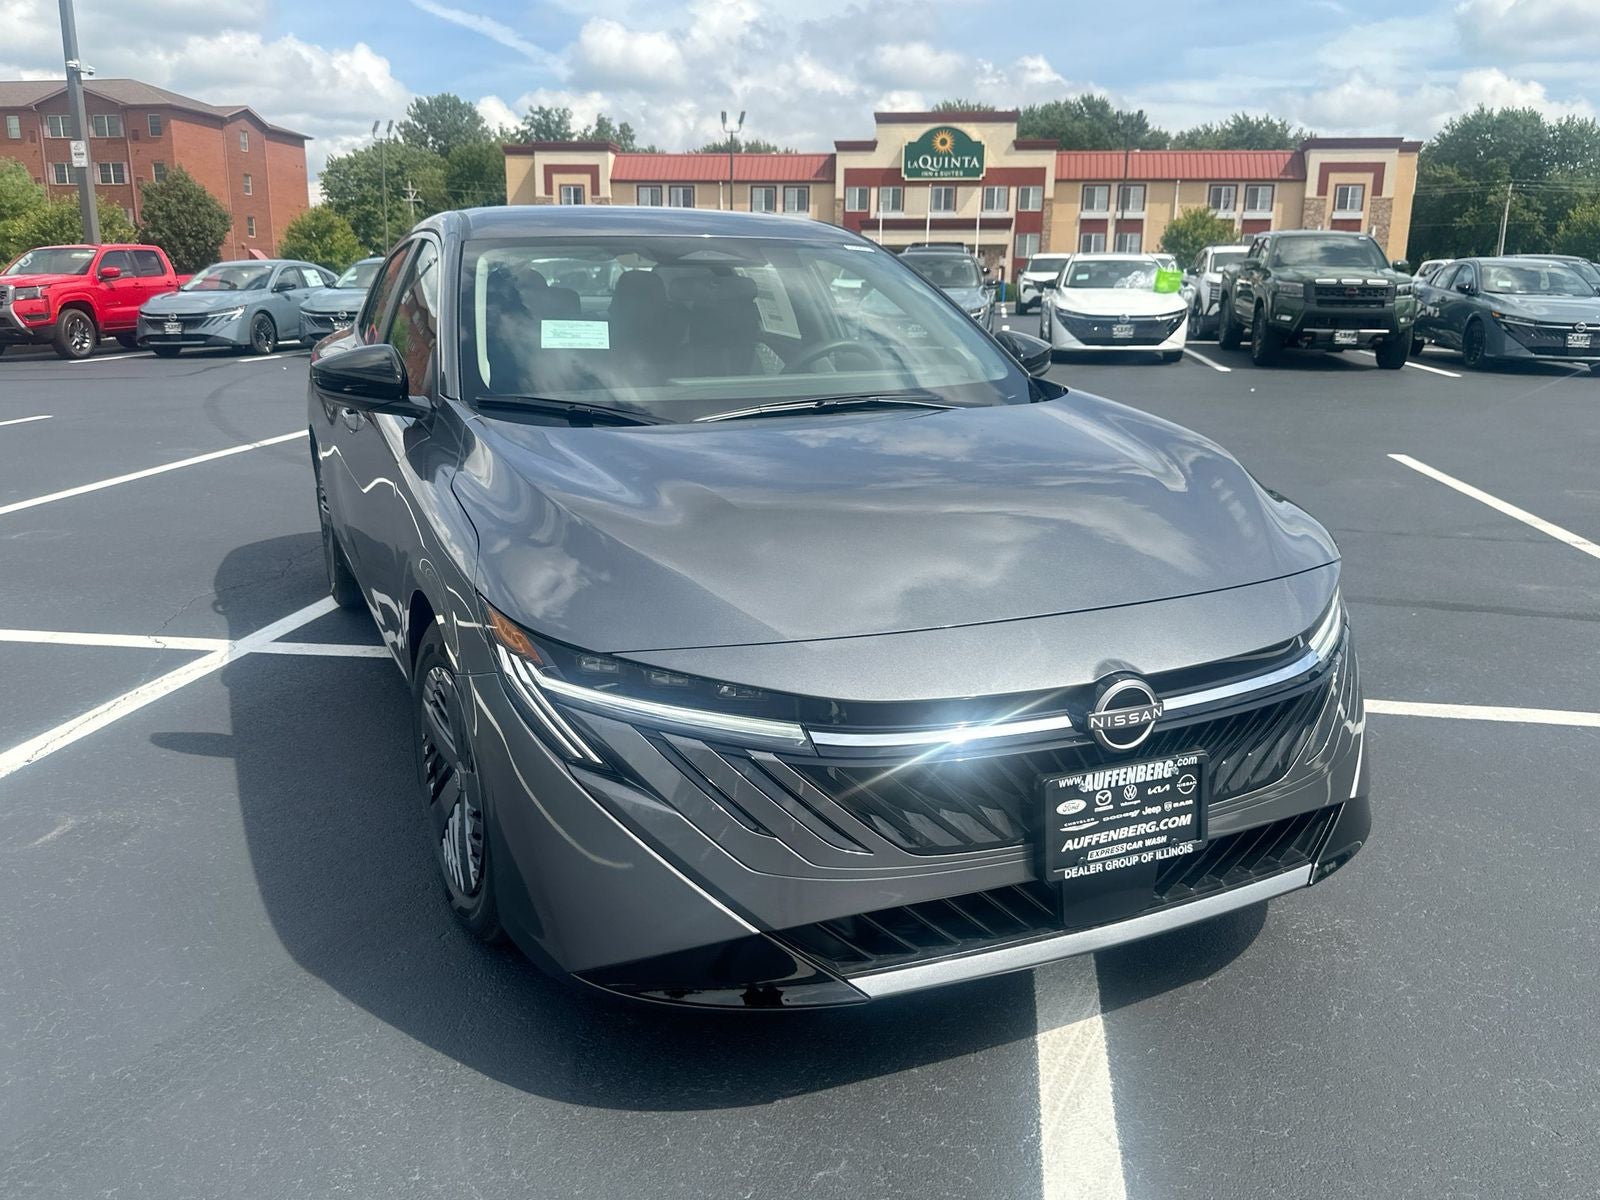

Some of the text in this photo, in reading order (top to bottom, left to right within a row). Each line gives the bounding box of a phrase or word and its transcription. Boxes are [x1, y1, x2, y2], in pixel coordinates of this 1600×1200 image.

[918, 154, 980, 172] QUINTA
[1090, 706, 1163, 729] NISSAN
[1142, 805, 1162, 816] Jeep
[1061, 814, 1193, 852] AUFFENBERG.COM
[1089, 835, 1168, 859] EXPRESS CAR WASH
[1064, 843, 1194, 880] DEALER GROUP OF ILLINOIS
